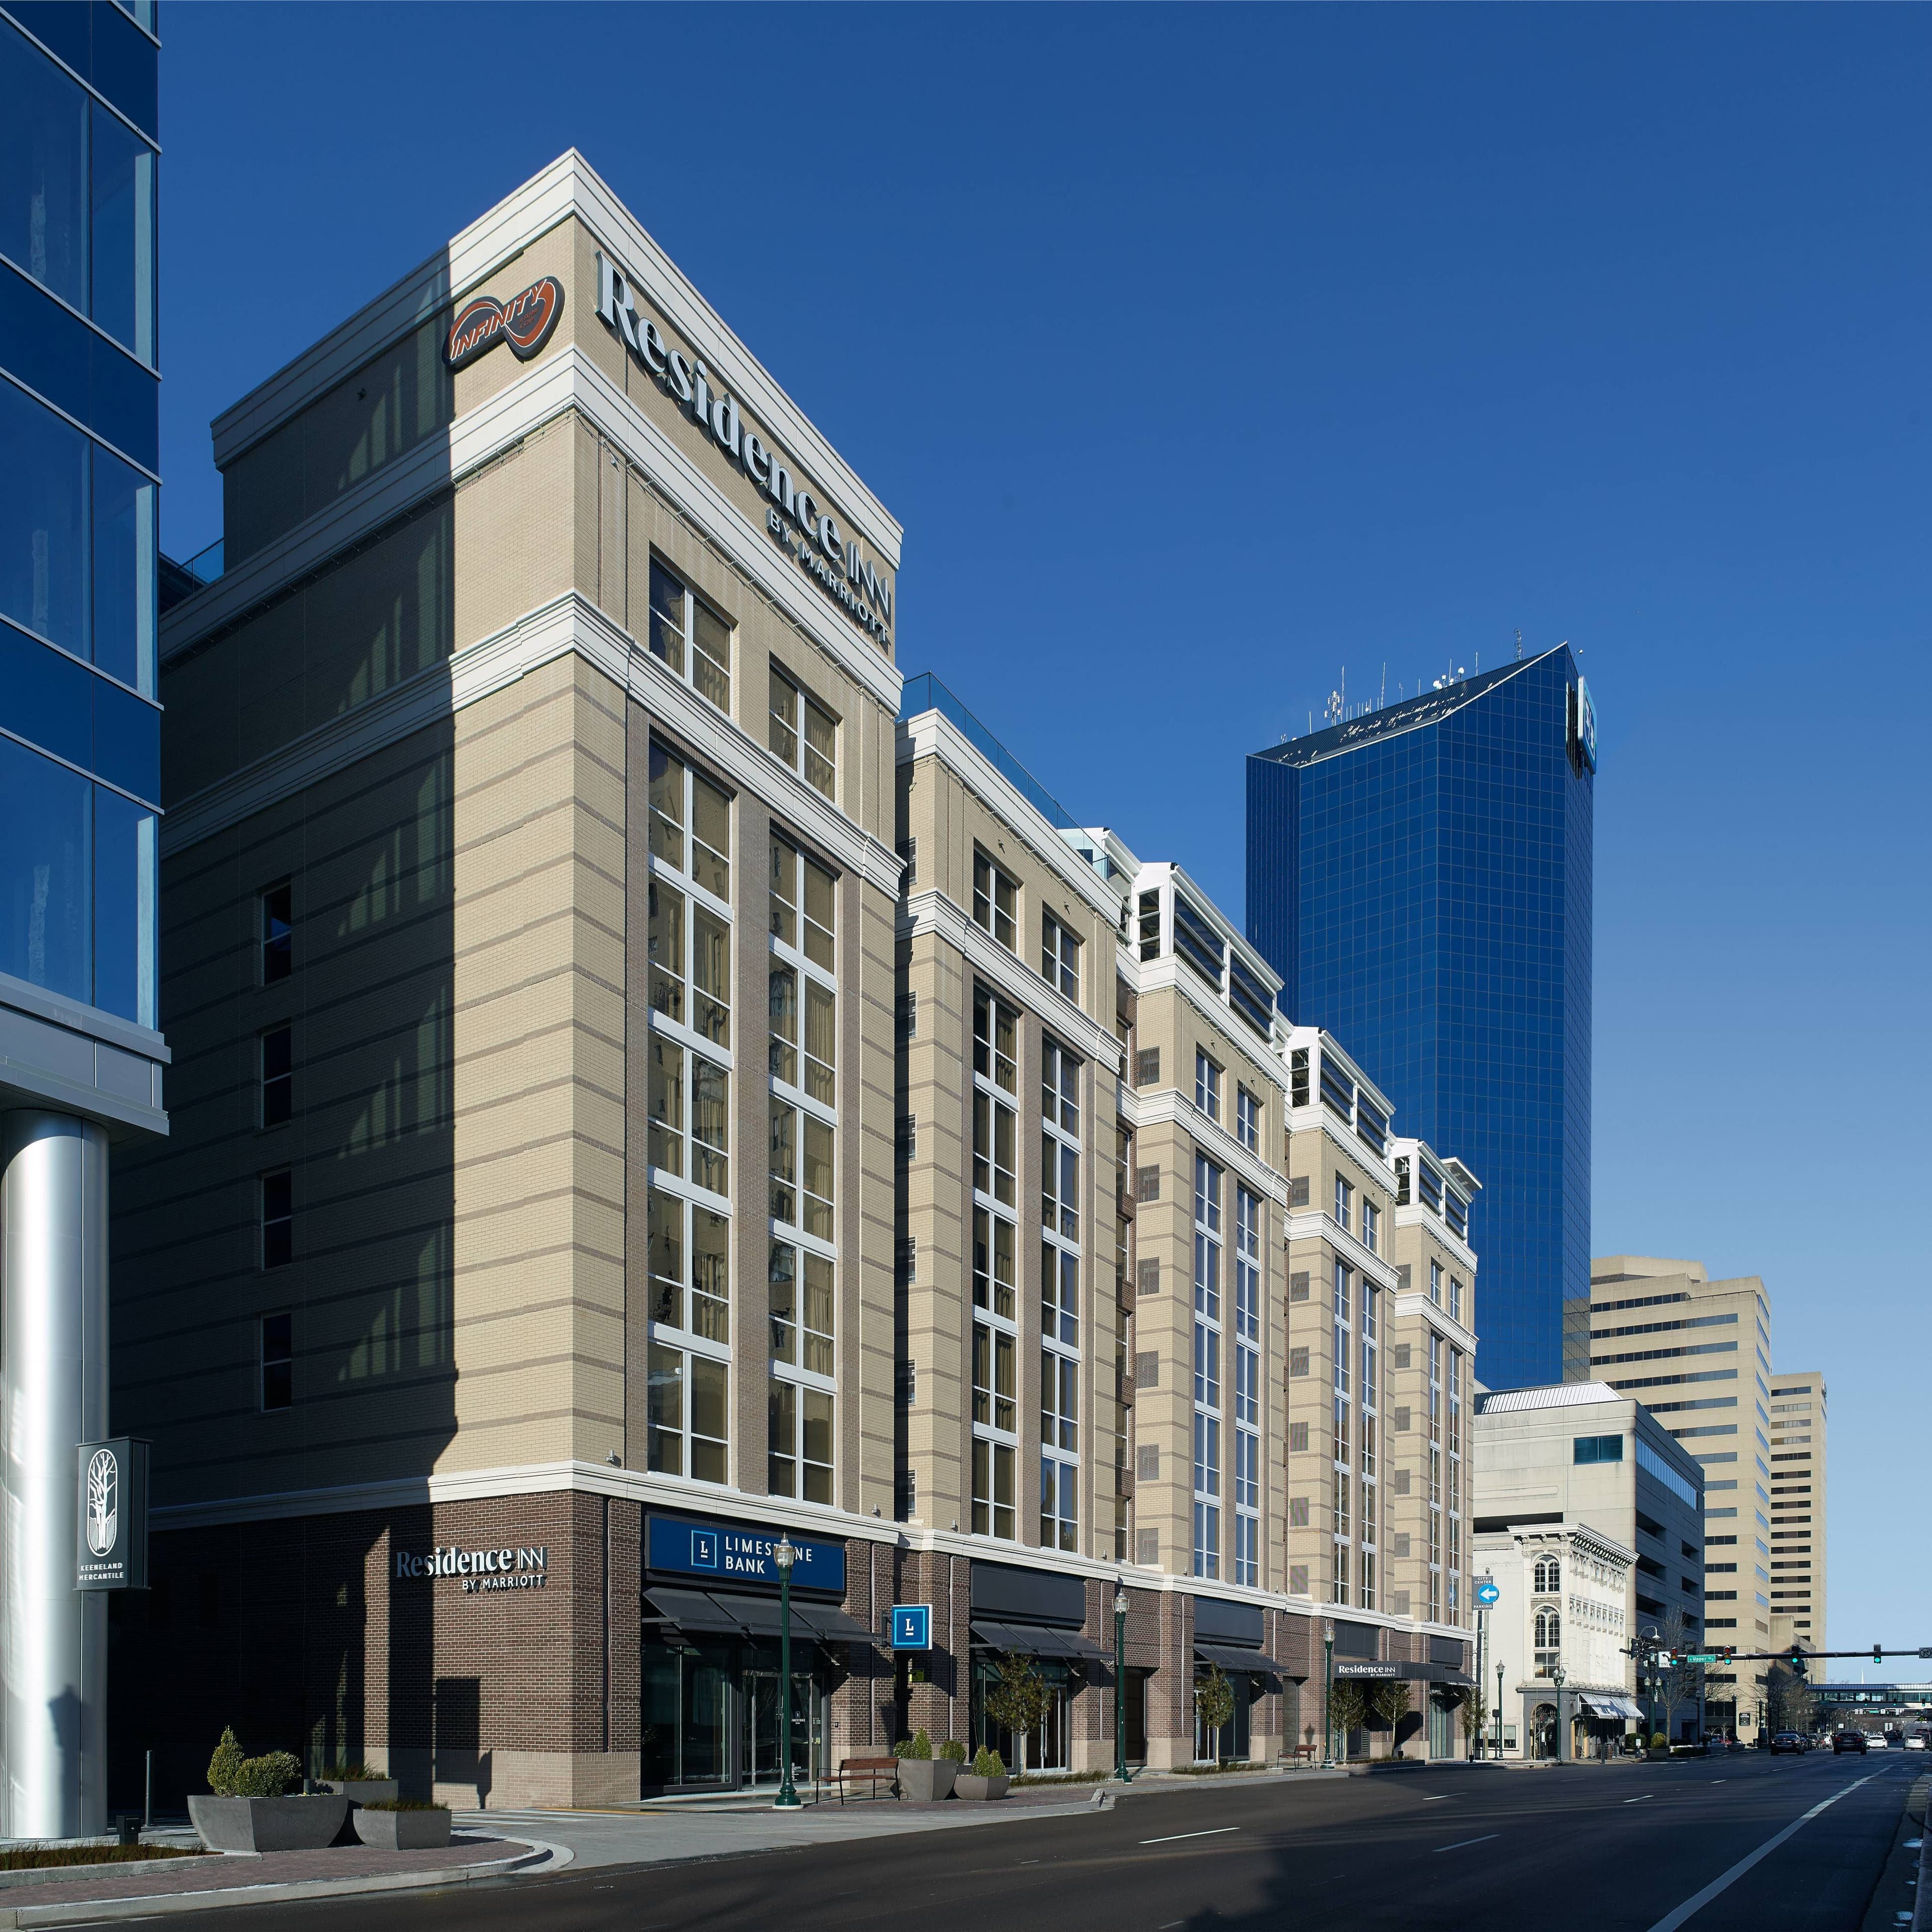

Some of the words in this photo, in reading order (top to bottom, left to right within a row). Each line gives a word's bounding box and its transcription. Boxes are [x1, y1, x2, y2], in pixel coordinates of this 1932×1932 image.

[451, 279, 547, 361] INFINITY
[596, 251, 841, 560] Residence
[847, 541, 889, 615] INN
[766, 508, 792, 543] BY
[798, 541, 888, 642] MARRIOTT
[701, 1541, 708, 1554] L
[726, 1536, 812, 1562] LIMESNE
[80, 1562, 123, 1571] KEENELAND
[396, 1547, 512, 1578] Residence
[518, 1547, 544, 1569] INN
[726, 1556, 765, 1574] BANK
[79, 1572, 124, 1580] MERCANTILE
[463, 1579, 476, 1590] BY
[483, 1575, 543, 1588] MARRIOTT
[906, 1619, 914, 1631] L
[1338, 1665, 1384, 1673] Residence
